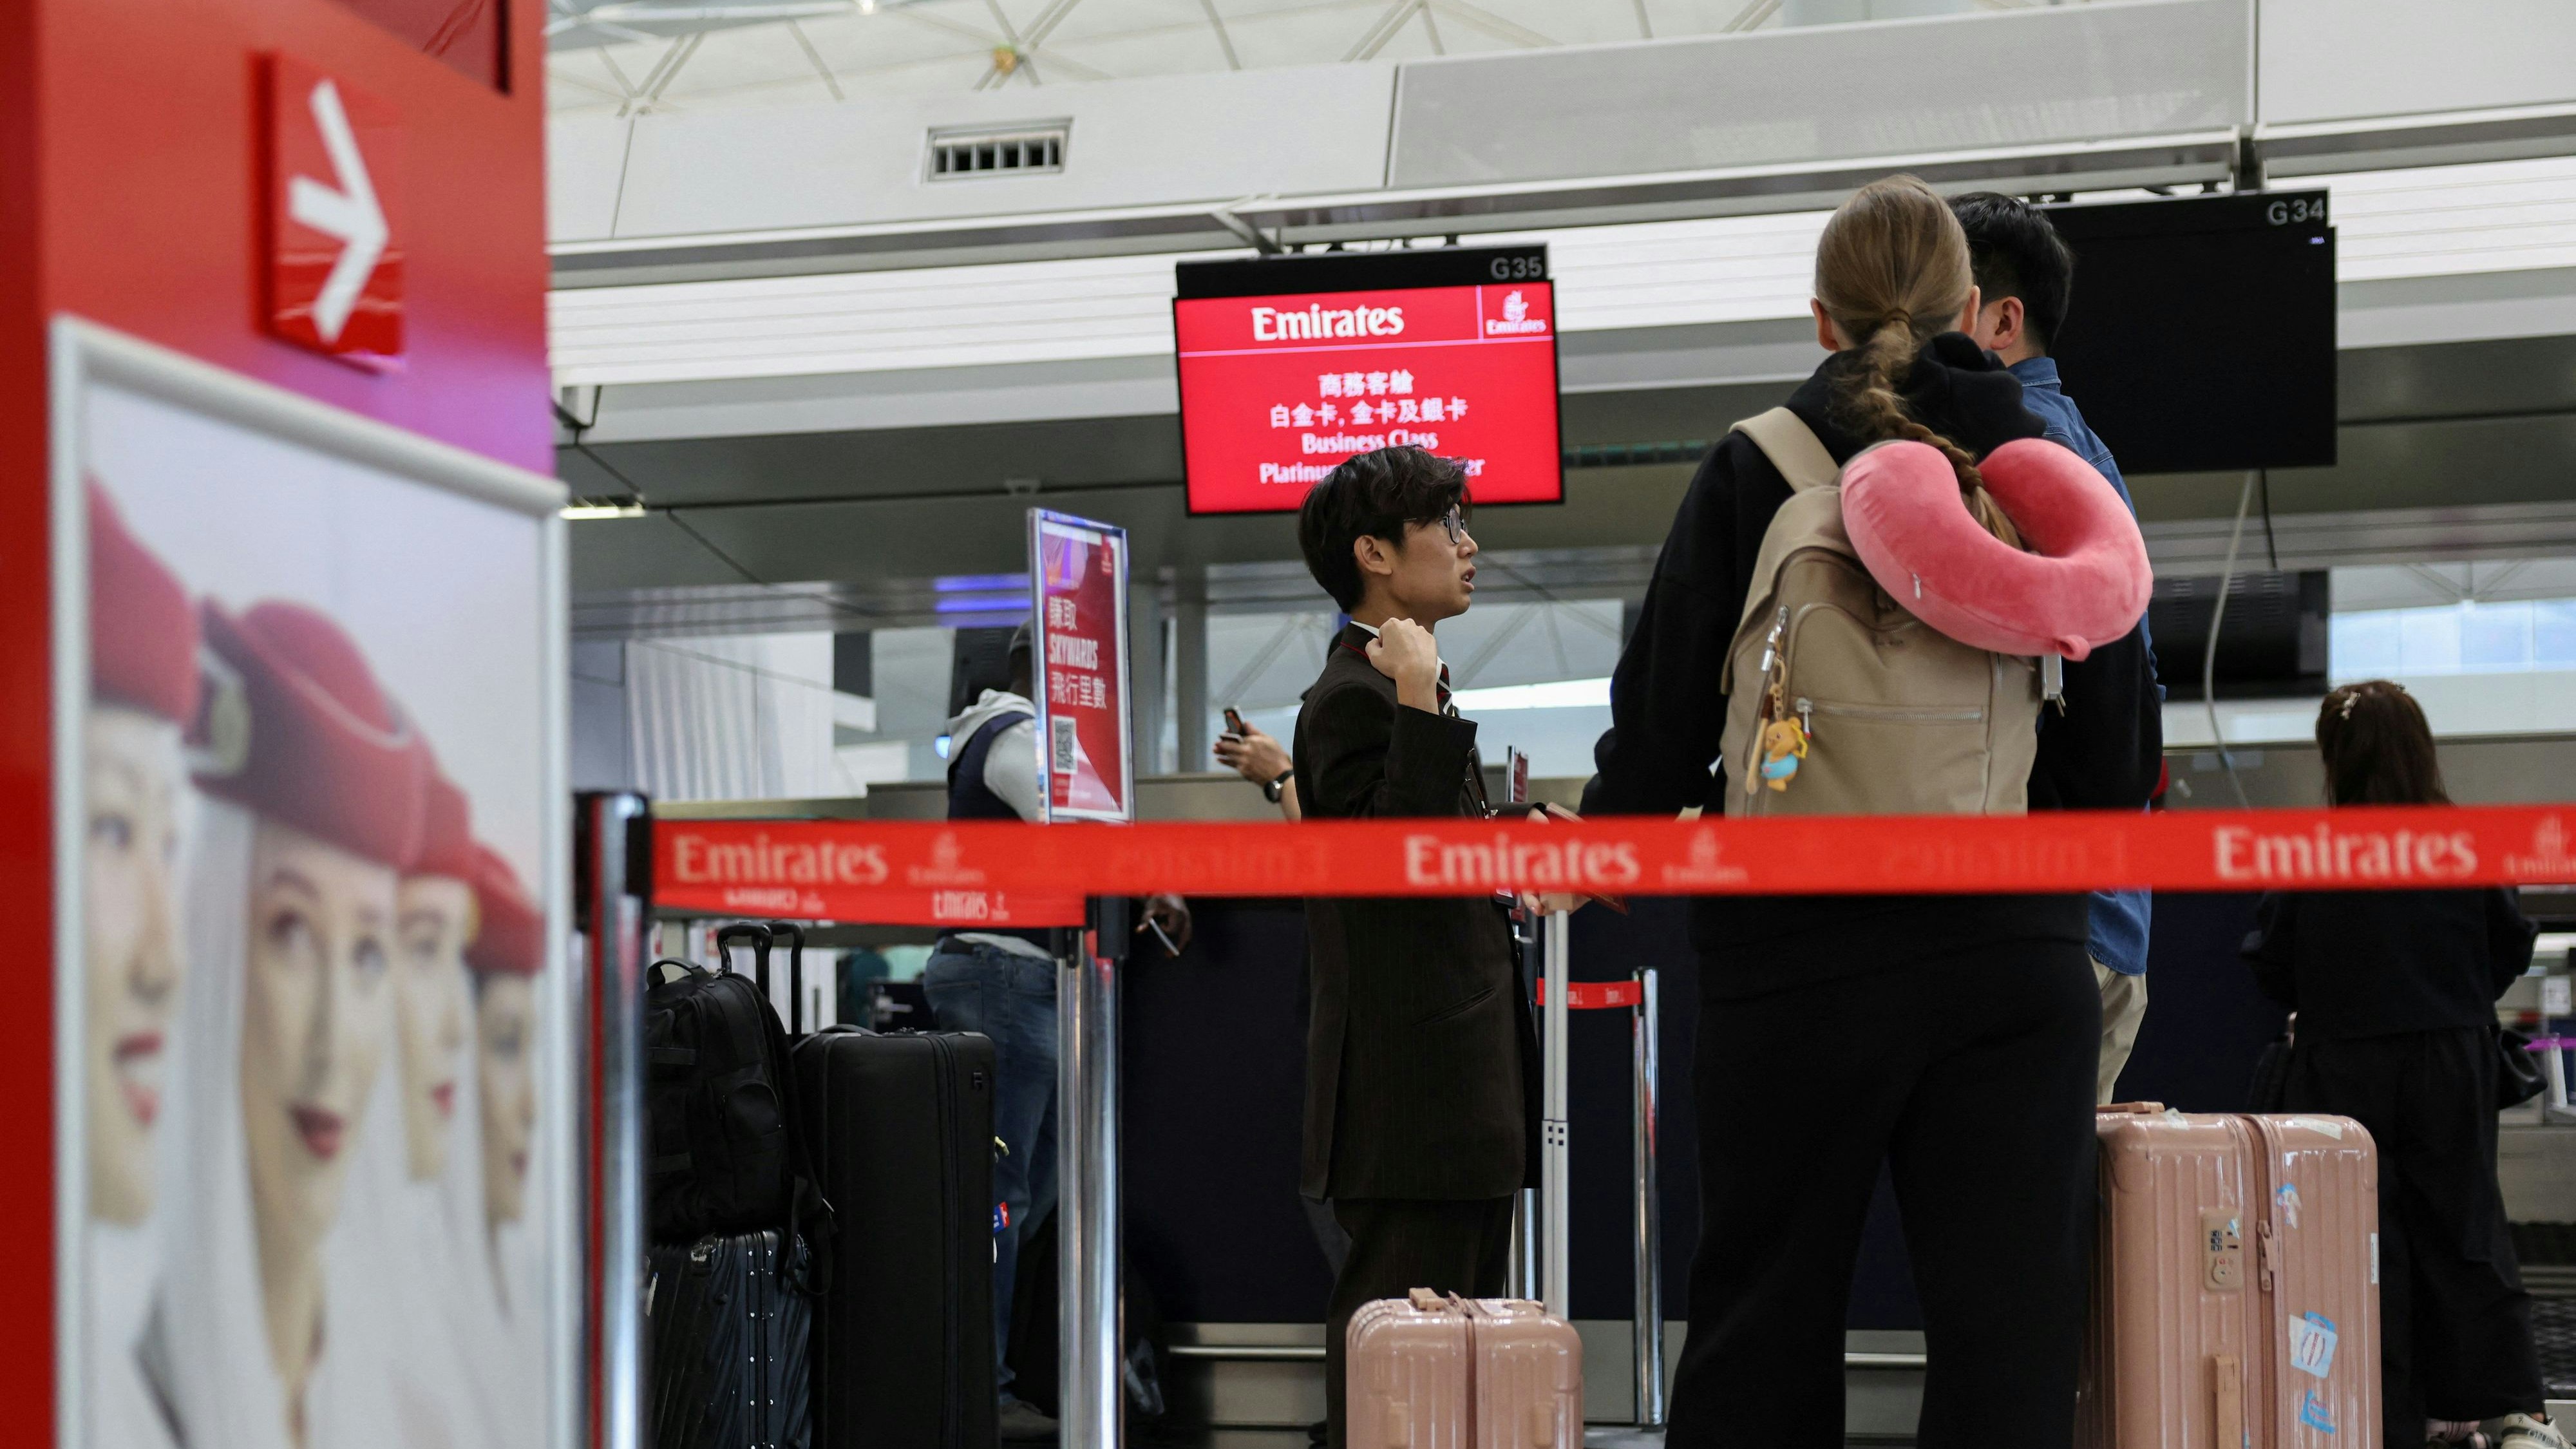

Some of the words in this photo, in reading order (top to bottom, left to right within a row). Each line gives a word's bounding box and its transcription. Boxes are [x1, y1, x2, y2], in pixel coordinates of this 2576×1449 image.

[2266, 198, 2325, 225] G34
[1490, 256, 1543, 279] G35
[1251, 303, 1405, 341] Emirates
[1486, 319, 1547, 335] Emirates
[1318, 369, 1414, 398] 商務客艙
[1302, 432, 1386, 455] Business
[1259, 462, 1336, 484] Platinu
[1049, 632, 1098, 670] SKYWARDS
[1051, 670, 1107, 710] 飛行里數
[674, 831, 888, 885] Emirates
[1404, 831, 1641, 886] Emirates
[2213, 821, 2478, 881] Emirates
